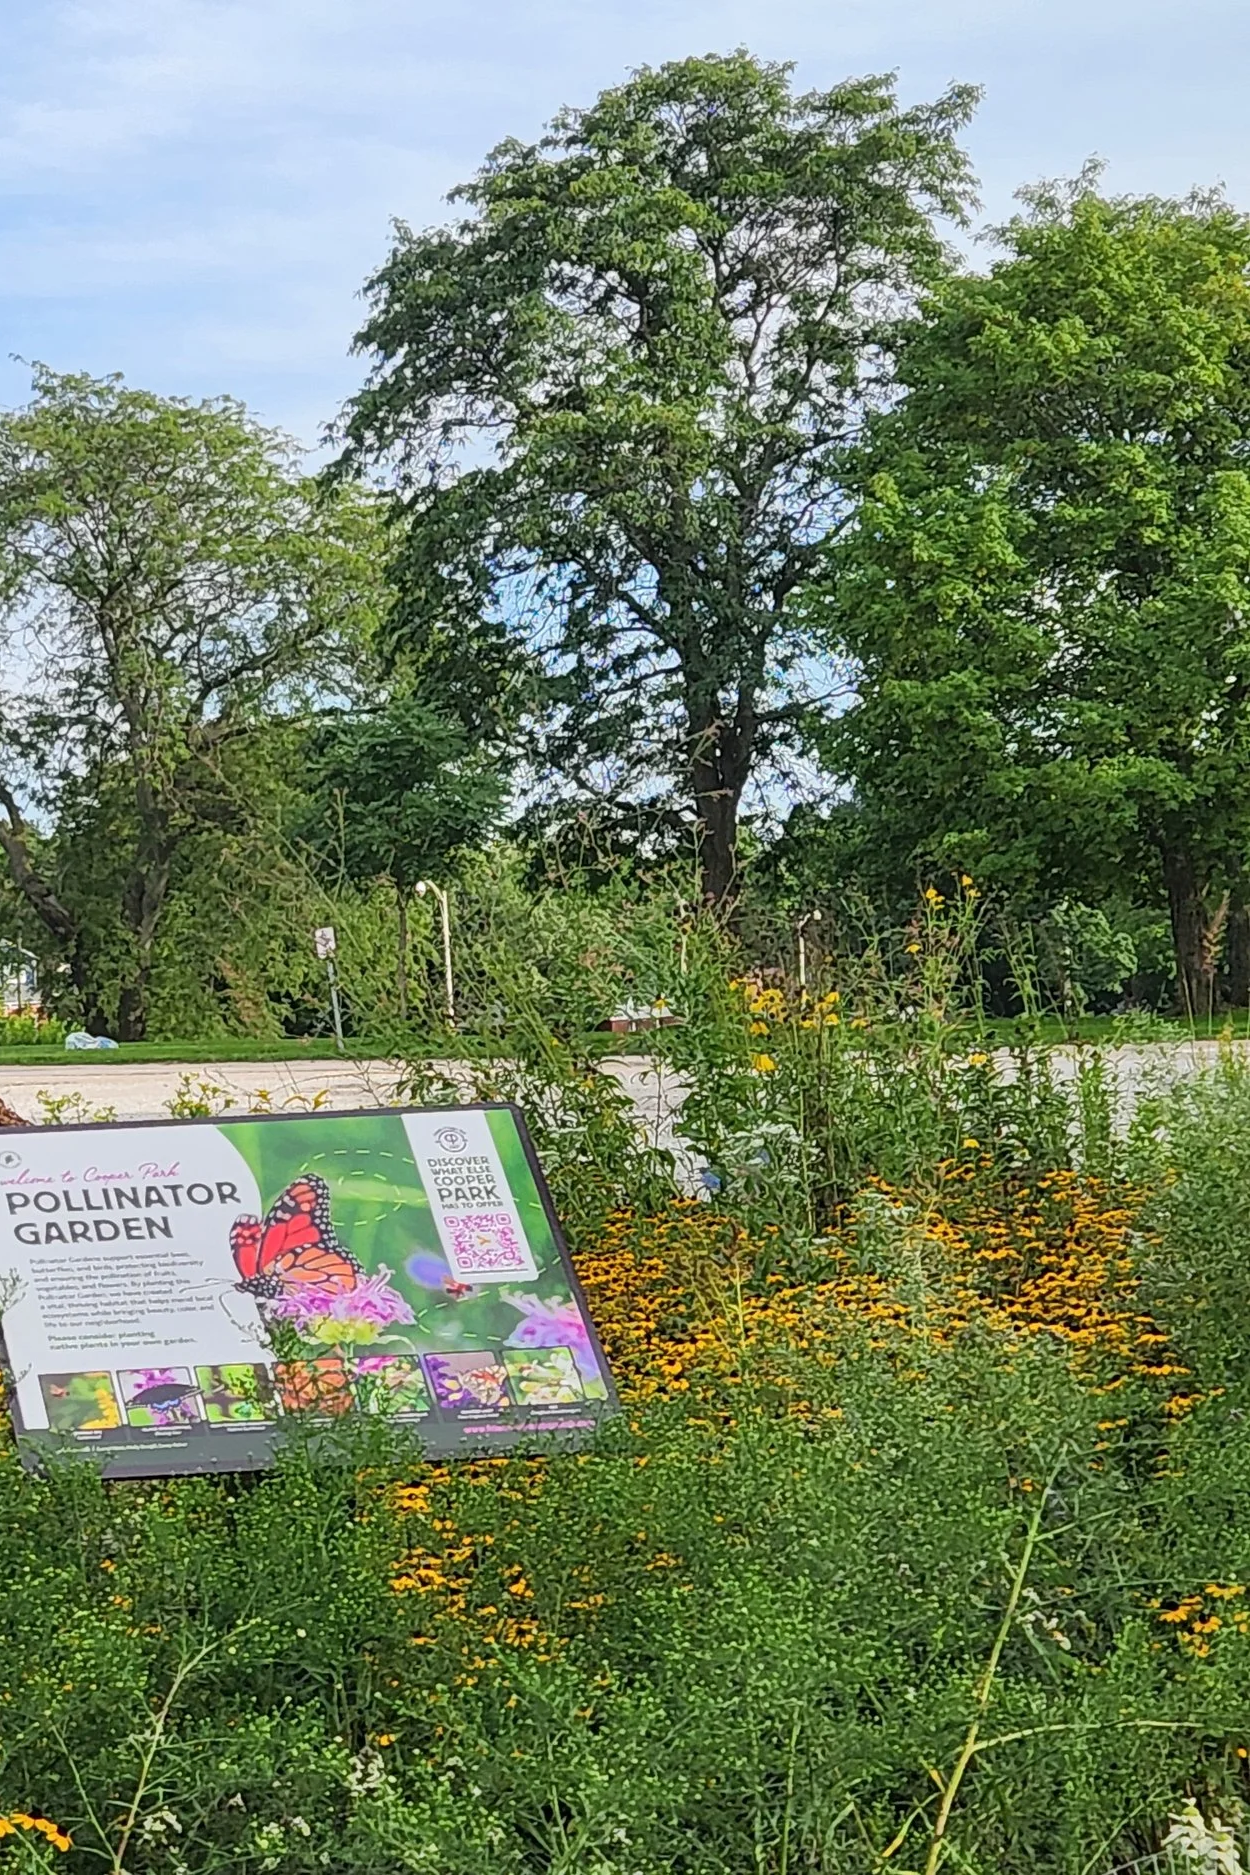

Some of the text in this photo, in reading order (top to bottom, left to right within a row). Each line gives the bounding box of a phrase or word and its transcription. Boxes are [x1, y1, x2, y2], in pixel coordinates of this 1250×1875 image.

[427, 1156, 490, 1167] DISCOVER
[0, 1162, 180, 1186] welcome to Cooper Park
[430, 1166, 492, 1175] WHAT ELSE
[434, 1174, 496, 1186] COOPER
[5, 1181, 242, 1216] POLLINATOR
[437, 1185, 501, 1202] PARK
[442, 1202, 460, 1210] HAS
[13, 1216, 174, 1245] GARDEN
